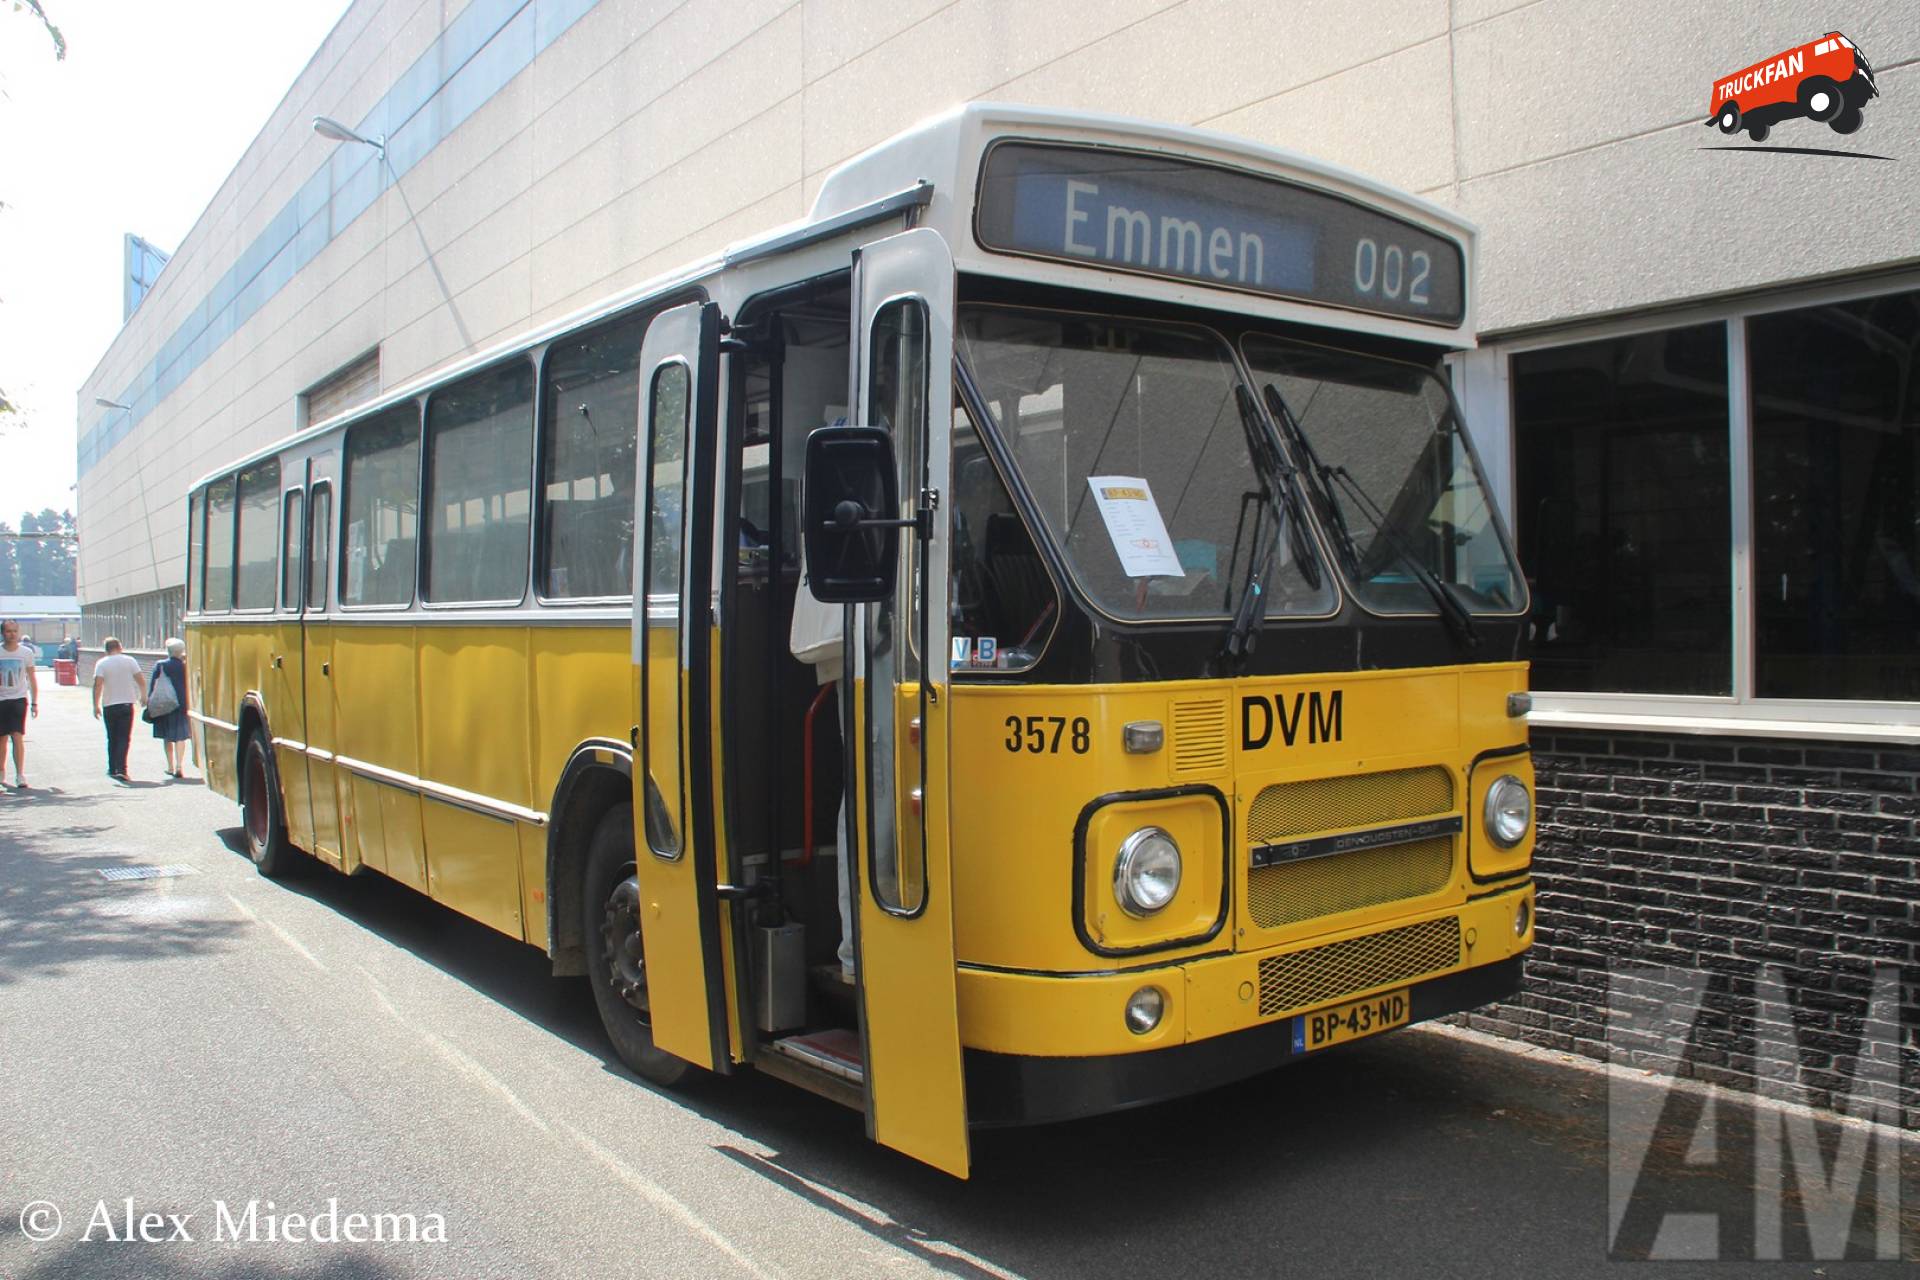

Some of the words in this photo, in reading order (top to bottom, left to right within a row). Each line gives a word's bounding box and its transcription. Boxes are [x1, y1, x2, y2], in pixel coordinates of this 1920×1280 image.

[1064, 179, 1264, 285] Emmen
[1354, 238, 1431, 305] 002
[1004, 715, 1091, 755] 3578
[1241, 689, 1343, 751] DVM
[1293, 1038, 1304, 1047] NL
[1311, 995, 1404, 1044] BP-43-ND
